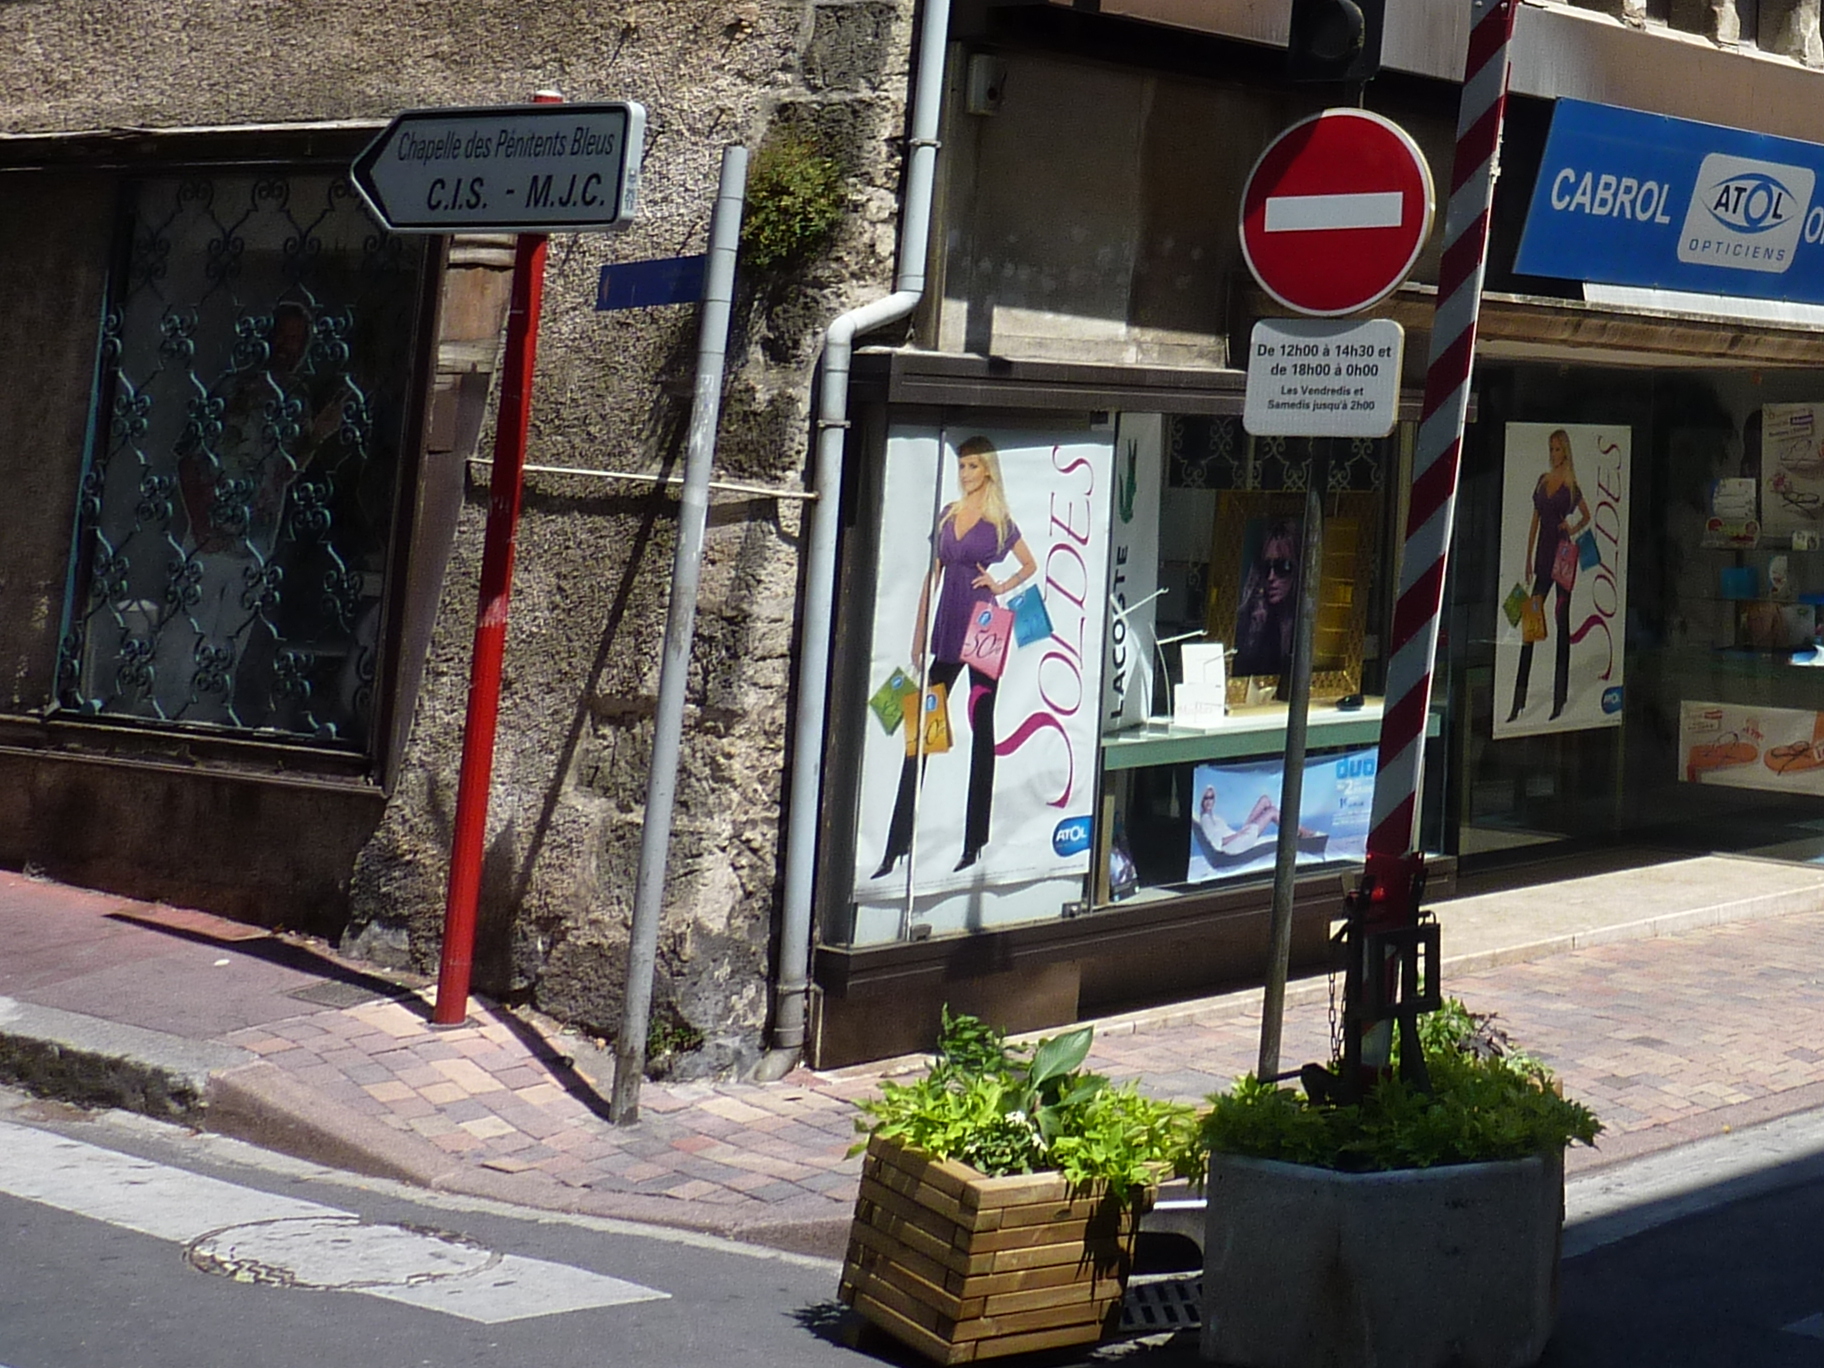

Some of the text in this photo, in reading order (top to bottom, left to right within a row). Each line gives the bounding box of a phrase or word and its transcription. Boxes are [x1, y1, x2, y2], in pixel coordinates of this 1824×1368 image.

[398, 127, 615, 165] Chapelle des Pénitents Bleus
[427, 176, 488, 210] C.I.S.
[525, 173, 605, 209] M.J.C.
[1551, 167, 1671, 225] CABROL
[1713, 182, 1784, 227] ATOL
[1689, 238, 1786, 262] OPTICIENS
[1257, 343, 1392, 358] De 12h00 à 14h30 et
[1271, 363, 1379, 377] de 18h00 à 0h00
[1267, 399, 1375, 411] Samedis jusqu'à 2h00
[1281, 385, 1364, 396] Les Vendredis et
[1557, 434, 1622, 682] SOLDES
[968, 445, 1095, 810] SOLDES
[1110, 544, 1129, 720] LACOSTE
[1336, 755, 1375, 779] duo
[1056, 825, 1087, 842] ATOL
